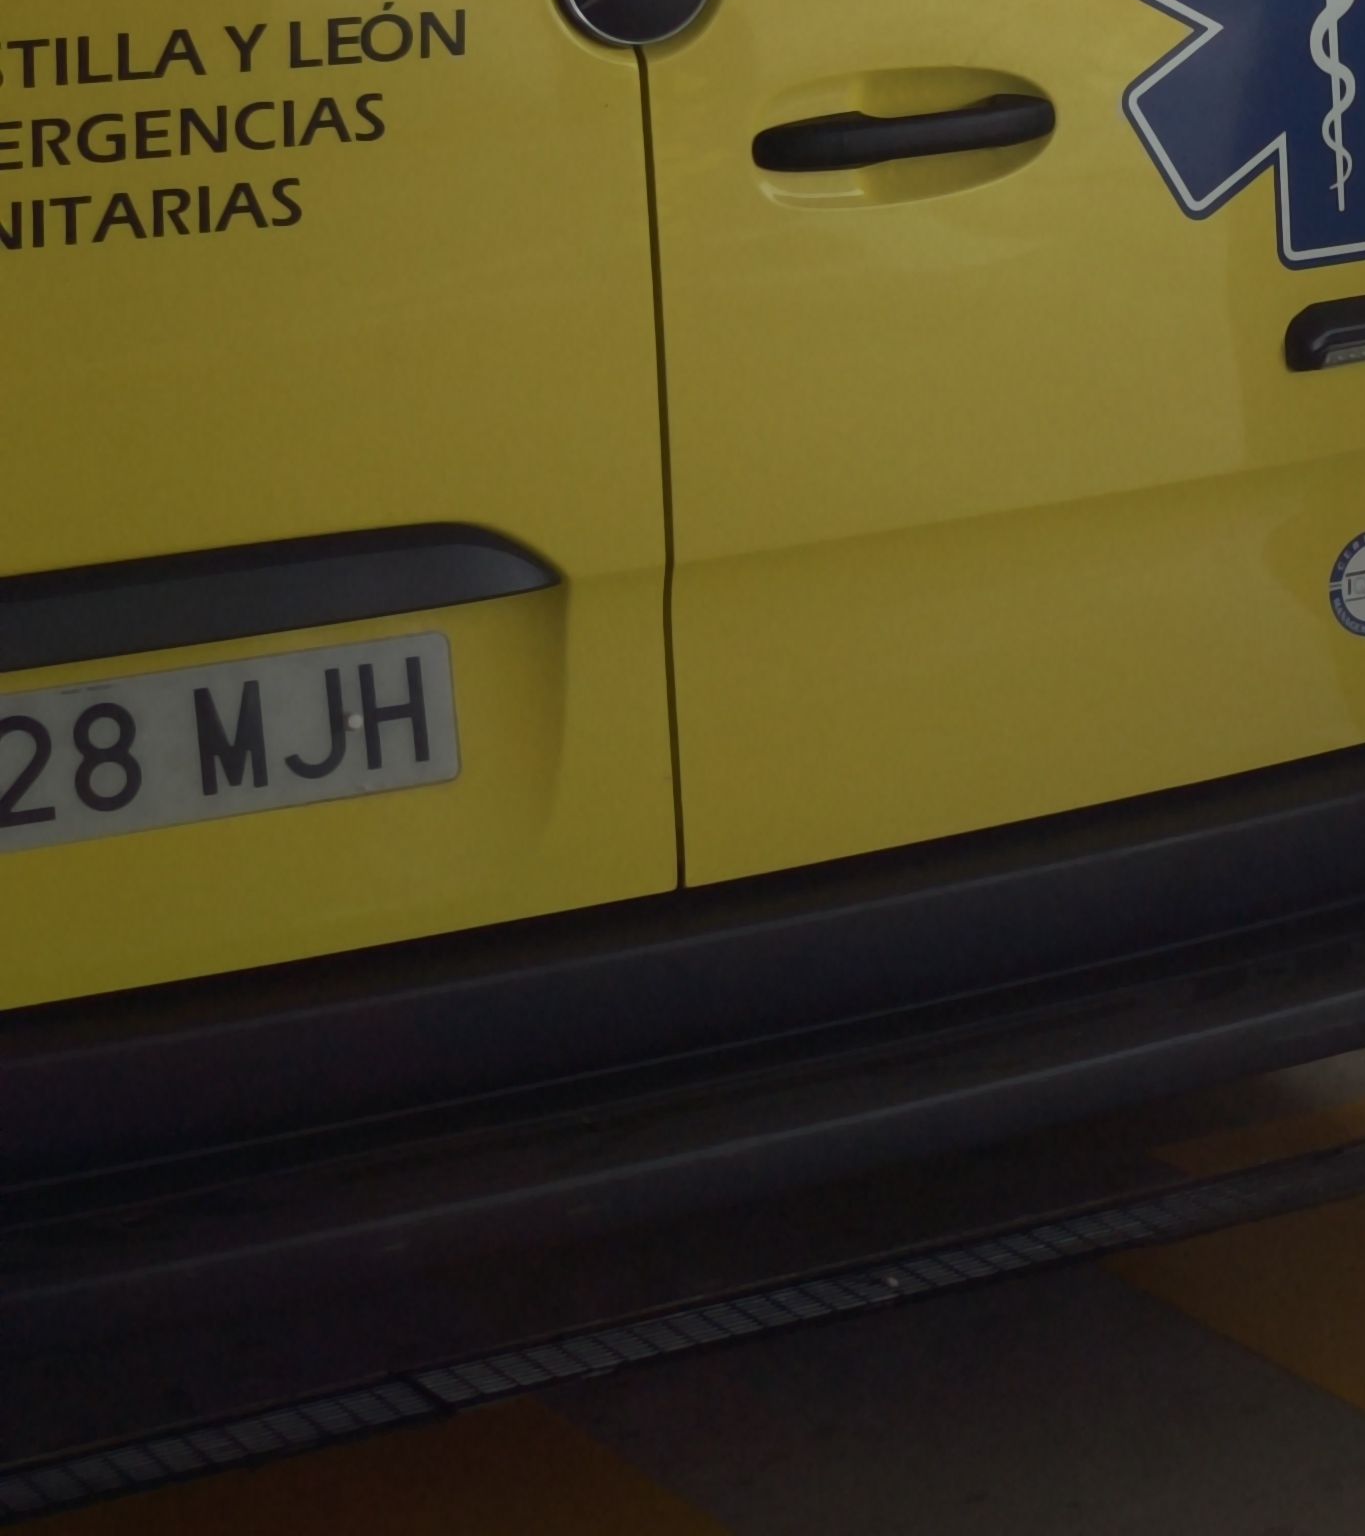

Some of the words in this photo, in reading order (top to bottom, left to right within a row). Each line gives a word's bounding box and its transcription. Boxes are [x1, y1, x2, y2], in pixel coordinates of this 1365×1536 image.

[0, 29, 207, 89] TILLA
[224, 23, 267, 72] Y
[289, 1, 466, 68] LEÓN
[0, 93, 386, 170] ERGENCIAS
[0, 701, 143, 829] 28
[193, 656, 430, 795] MJH
